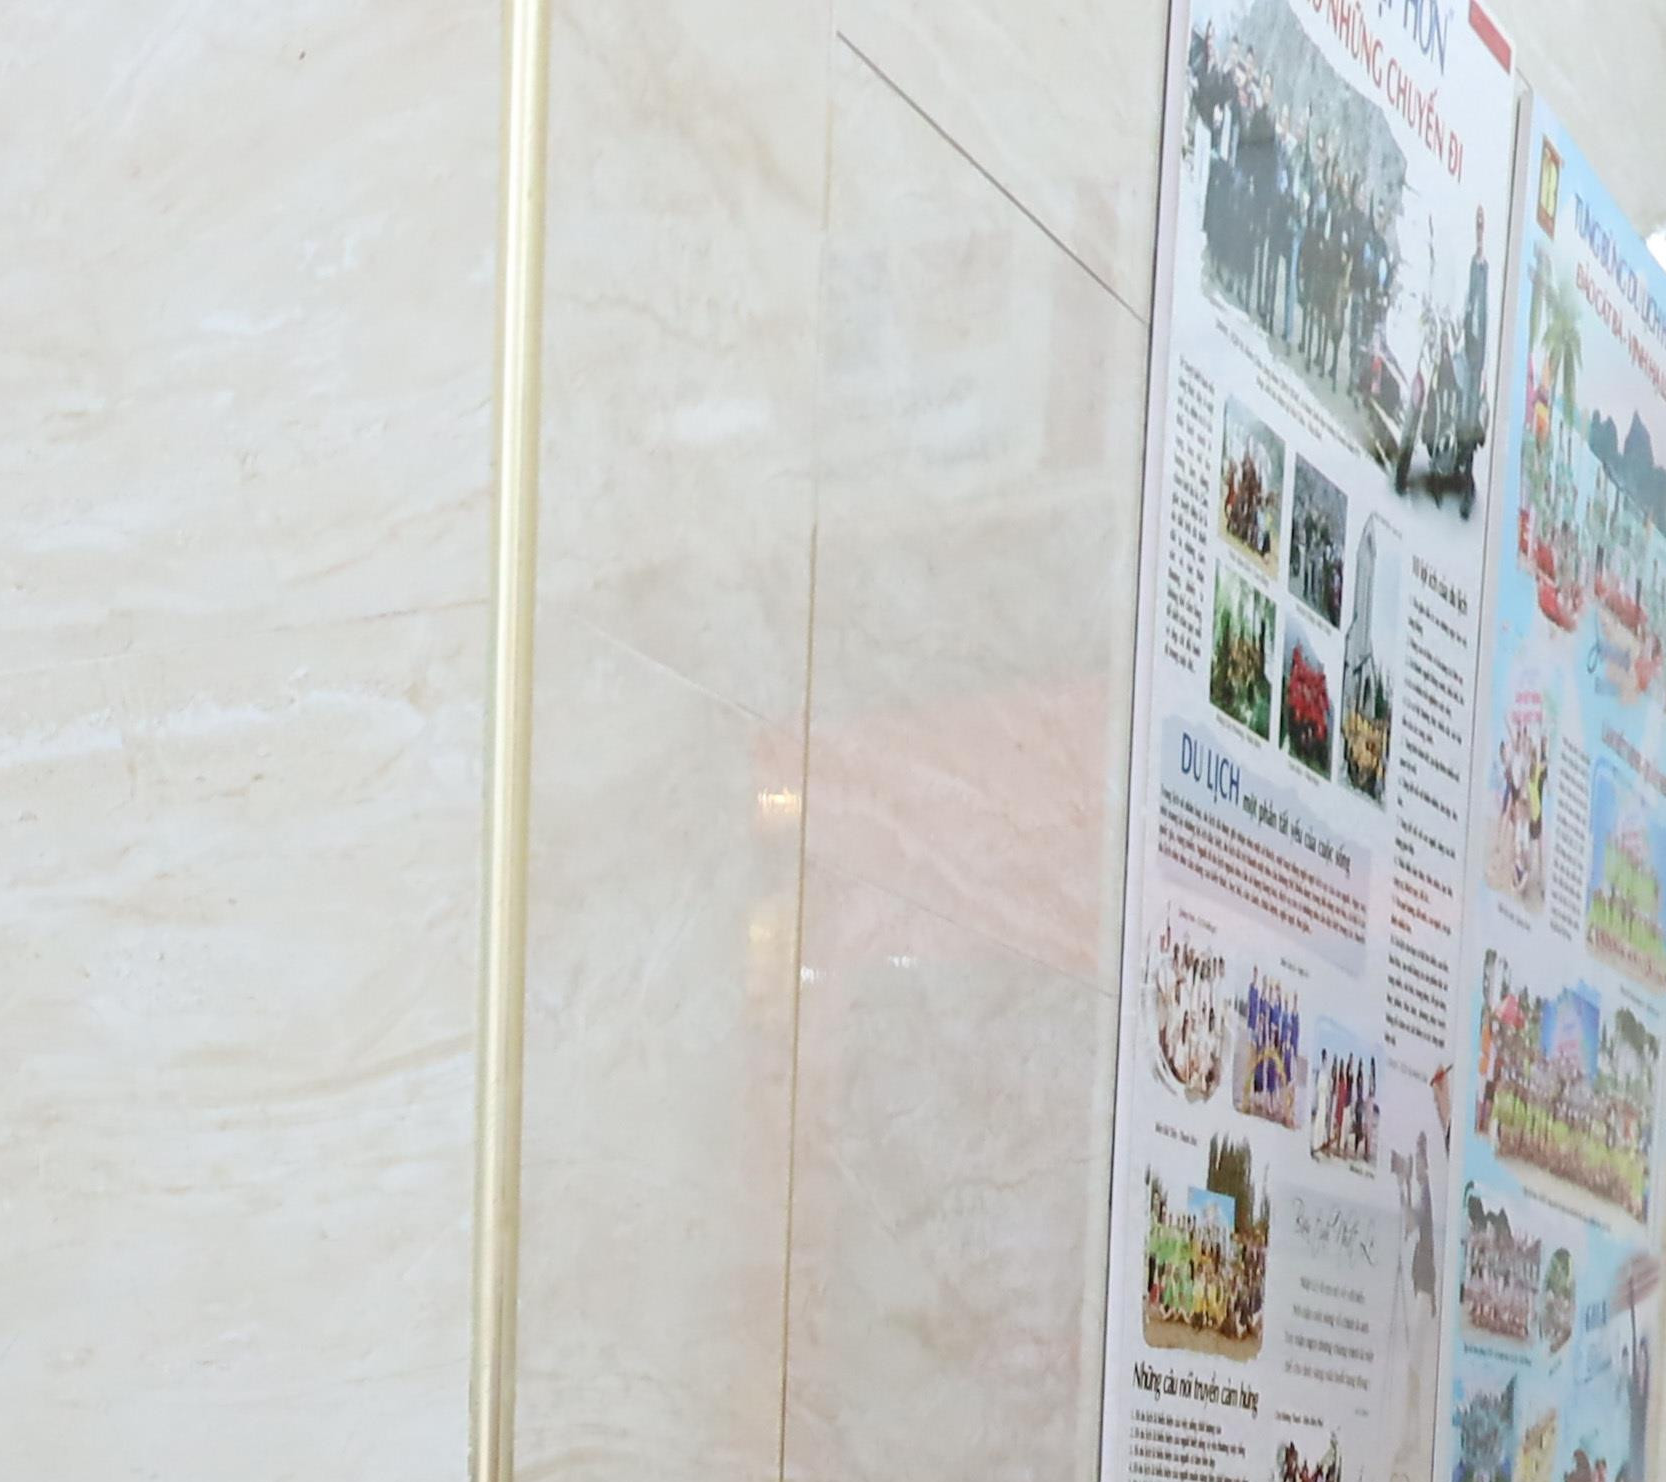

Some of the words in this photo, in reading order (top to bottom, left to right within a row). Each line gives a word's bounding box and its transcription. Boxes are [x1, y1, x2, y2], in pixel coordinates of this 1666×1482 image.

[1447, 130, 1464, 184] ĐI
[1181, 732, 1205, 782] DU
[1207, 750, 1241, 805] LỊCH
